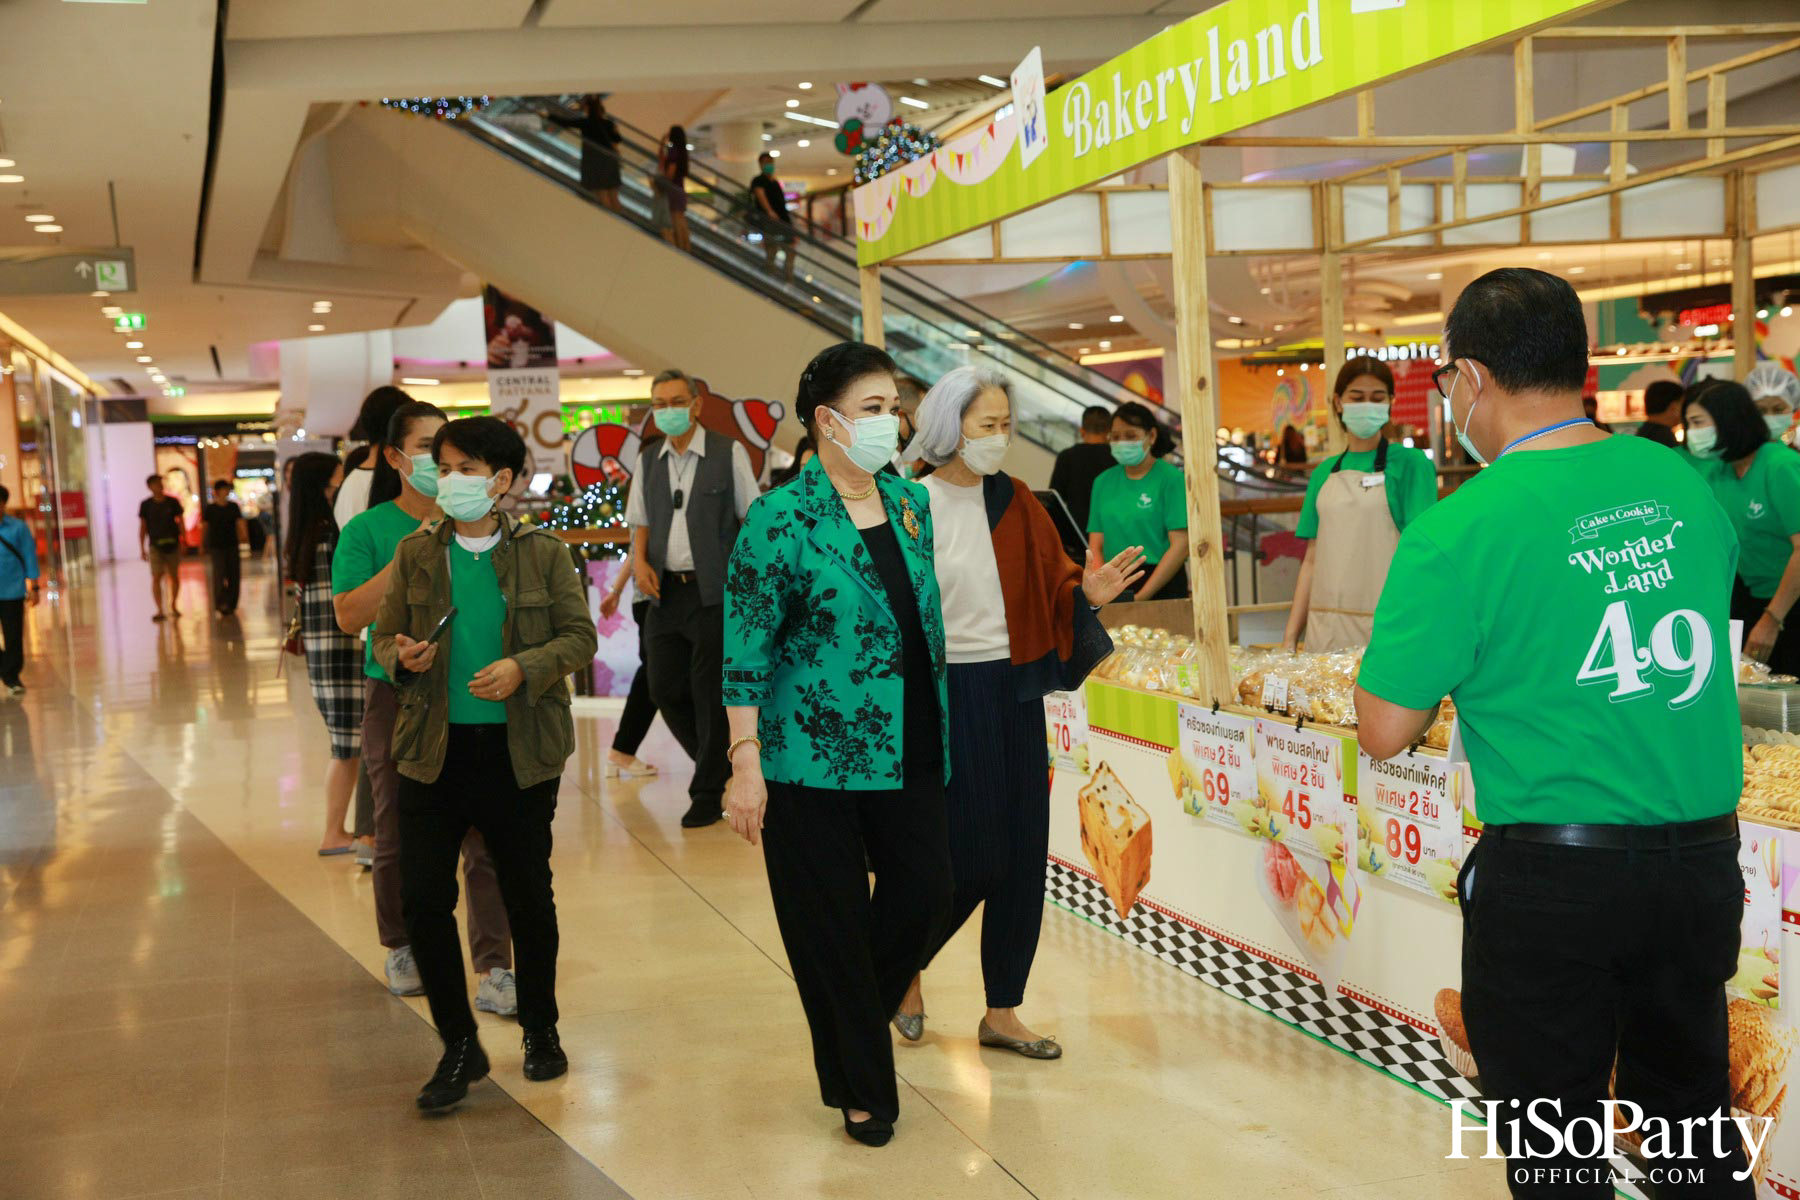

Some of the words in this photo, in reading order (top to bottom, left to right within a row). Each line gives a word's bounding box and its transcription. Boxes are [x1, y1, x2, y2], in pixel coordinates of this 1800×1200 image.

[1062, 0, 1323, 159] Bakeryland
[496, 375, 550, 386] CENTRAL
[498, 387, 552, 396] PATTANA
[1579, 513, 1609, 531] Cake
[1615, 504, 1655, 521] Cookie
[1568, 520, 1683, 575] Wonder
[1604, 558, 1674, 595] Land
[1576, 600, 1716, 710] 49
[1053, 721, 1071, 753] 70
[1218, 744, 1226, 767] 2
[1228, 743, 1241, 768] ชิ้น
[1203, 767, 1230, 807] 69
[1272, 755, 1298, 781] พิเศษ
[1300, 763, 1309, 787] 2
[1311, 763, 1325, 790] ชิ้น
[1370, 757, 1447, 798] ครวซองท์แพ็คคู่
[1282, 788, 1312, 831] 45
[1375, 782, 1406, 809] พิเศษ
[1409, 790, 1419, 816] 2
[1422, 790, 1439, 819] ชิ้น
[1385, 816, 1421, 866] 89
